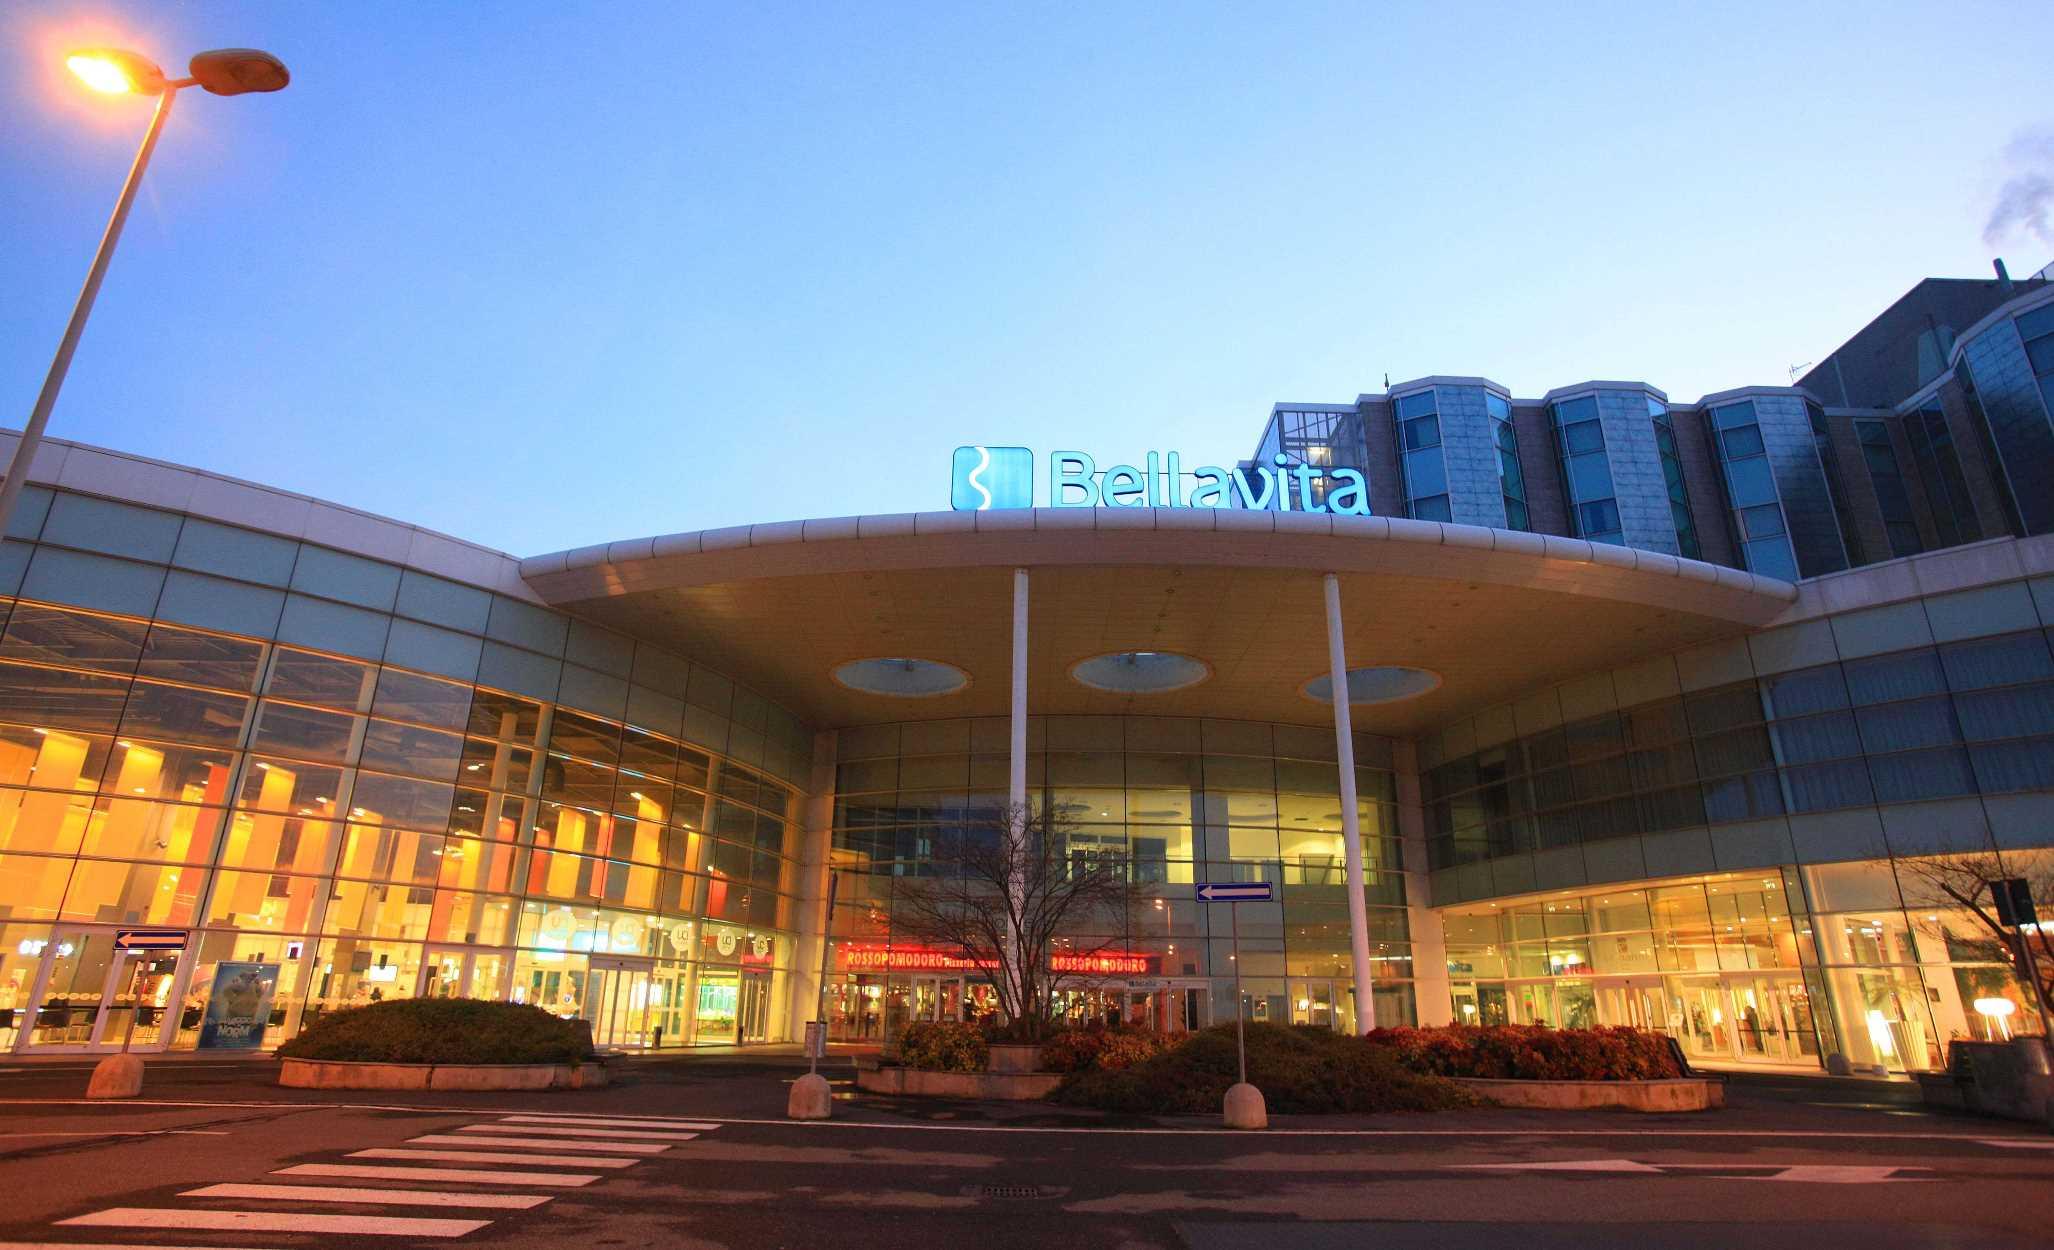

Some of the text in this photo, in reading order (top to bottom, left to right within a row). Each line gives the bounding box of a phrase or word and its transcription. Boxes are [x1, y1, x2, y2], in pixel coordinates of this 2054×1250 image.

[1051, 451, 1371, 516] Bellavita
[847, 951, 944, 967] ROSSOPOMODORO
[1051, 957, 1147, 973] ROSSOPOMODORO
